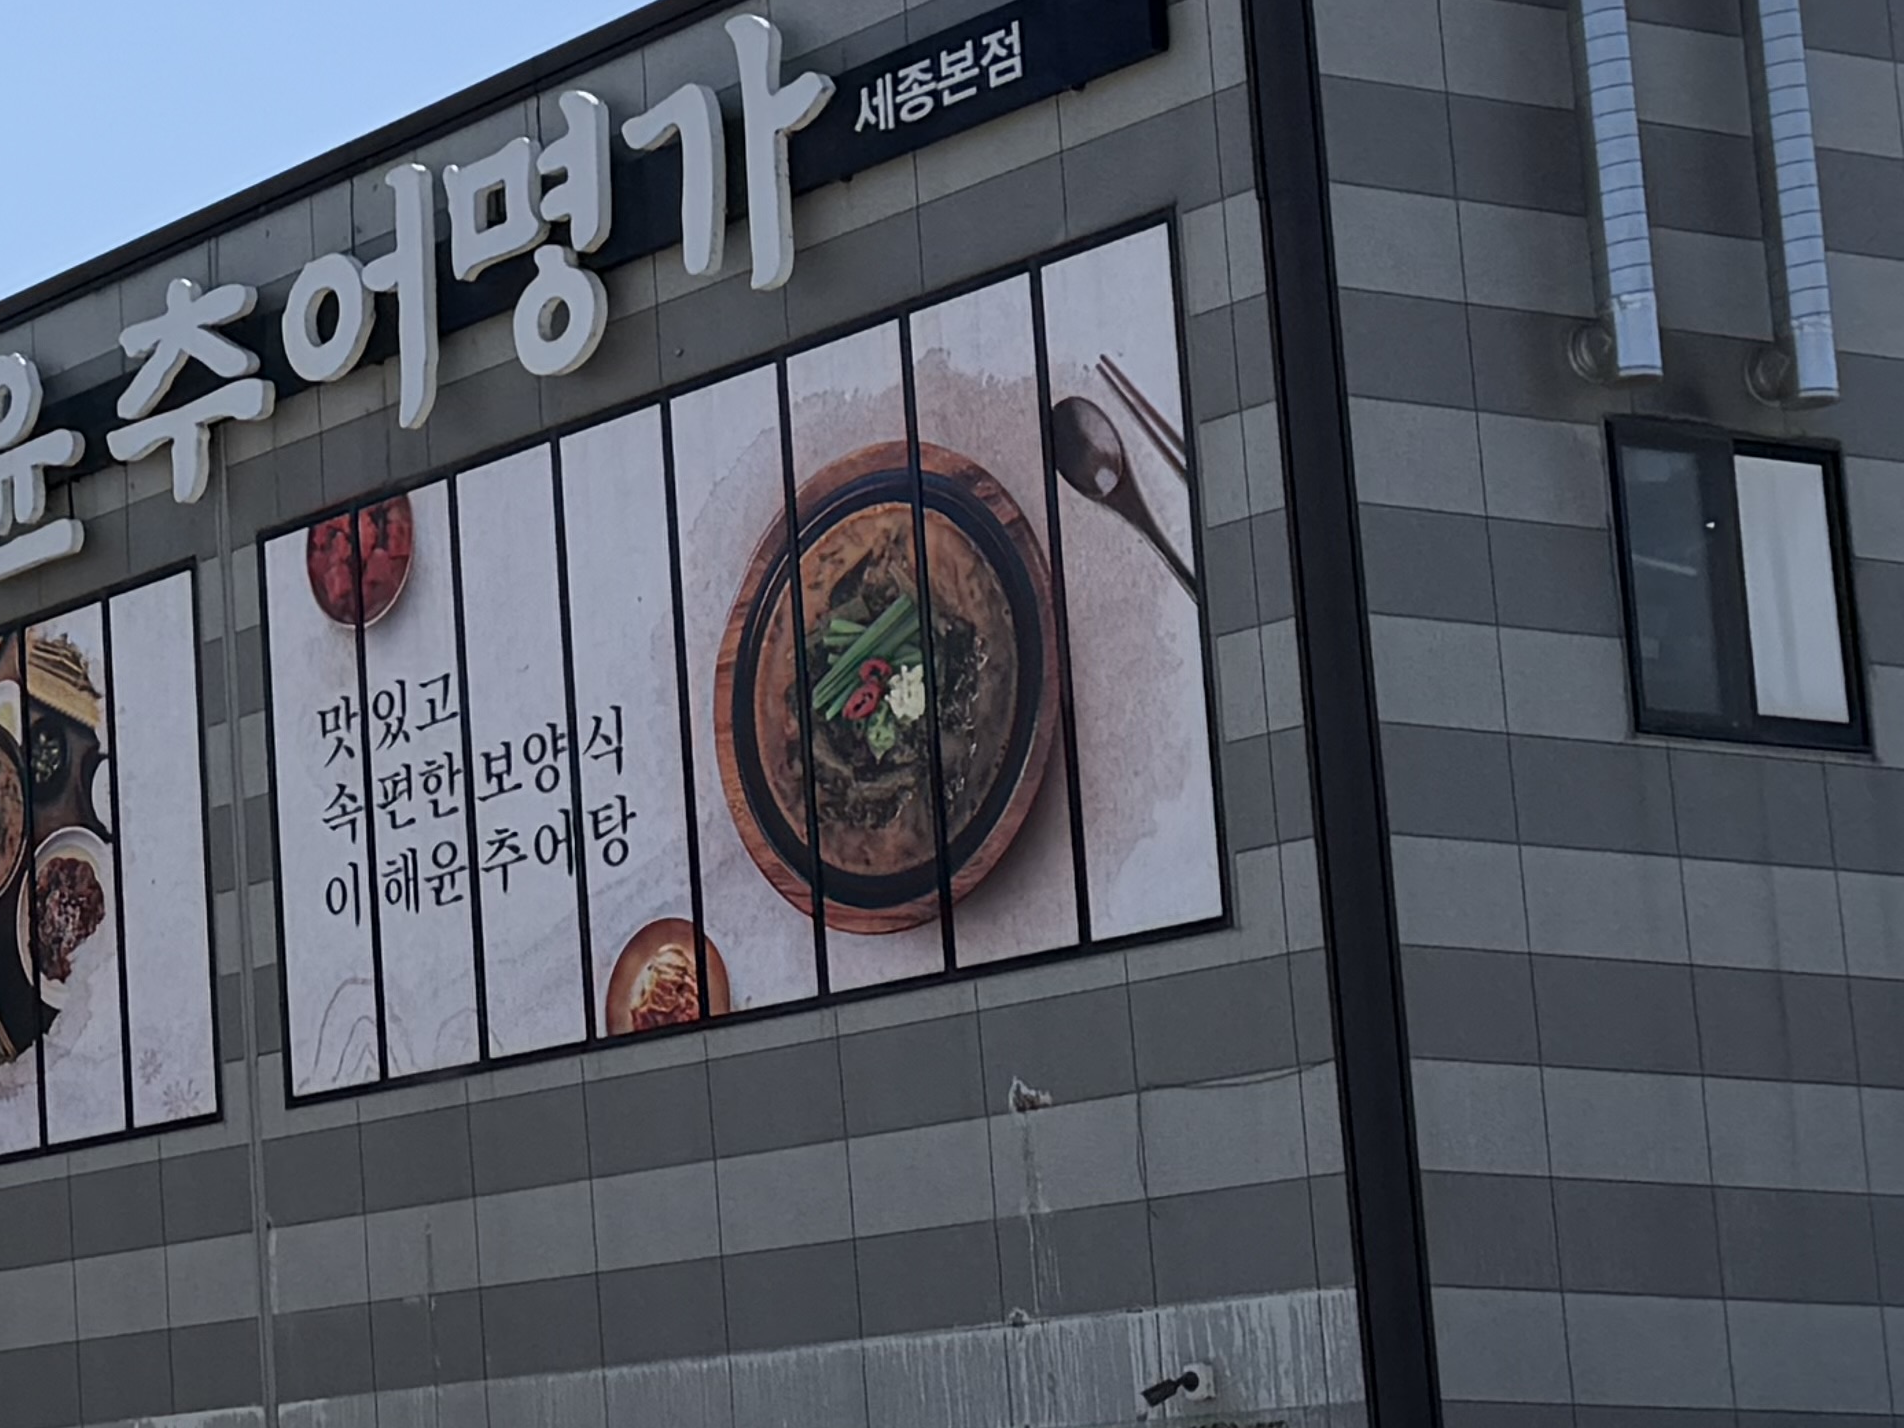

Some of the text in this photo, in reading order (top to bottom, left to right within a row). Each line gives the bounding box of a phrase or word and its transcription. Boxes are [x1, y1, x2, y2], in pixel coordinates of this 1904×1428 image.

[853, 20, 1024, 134] 세종본점
[106, 13, 835, 504] 추어명가
[317, 673, 459, 767] 맛있고
[477, 705, 623, 802] 보양식
